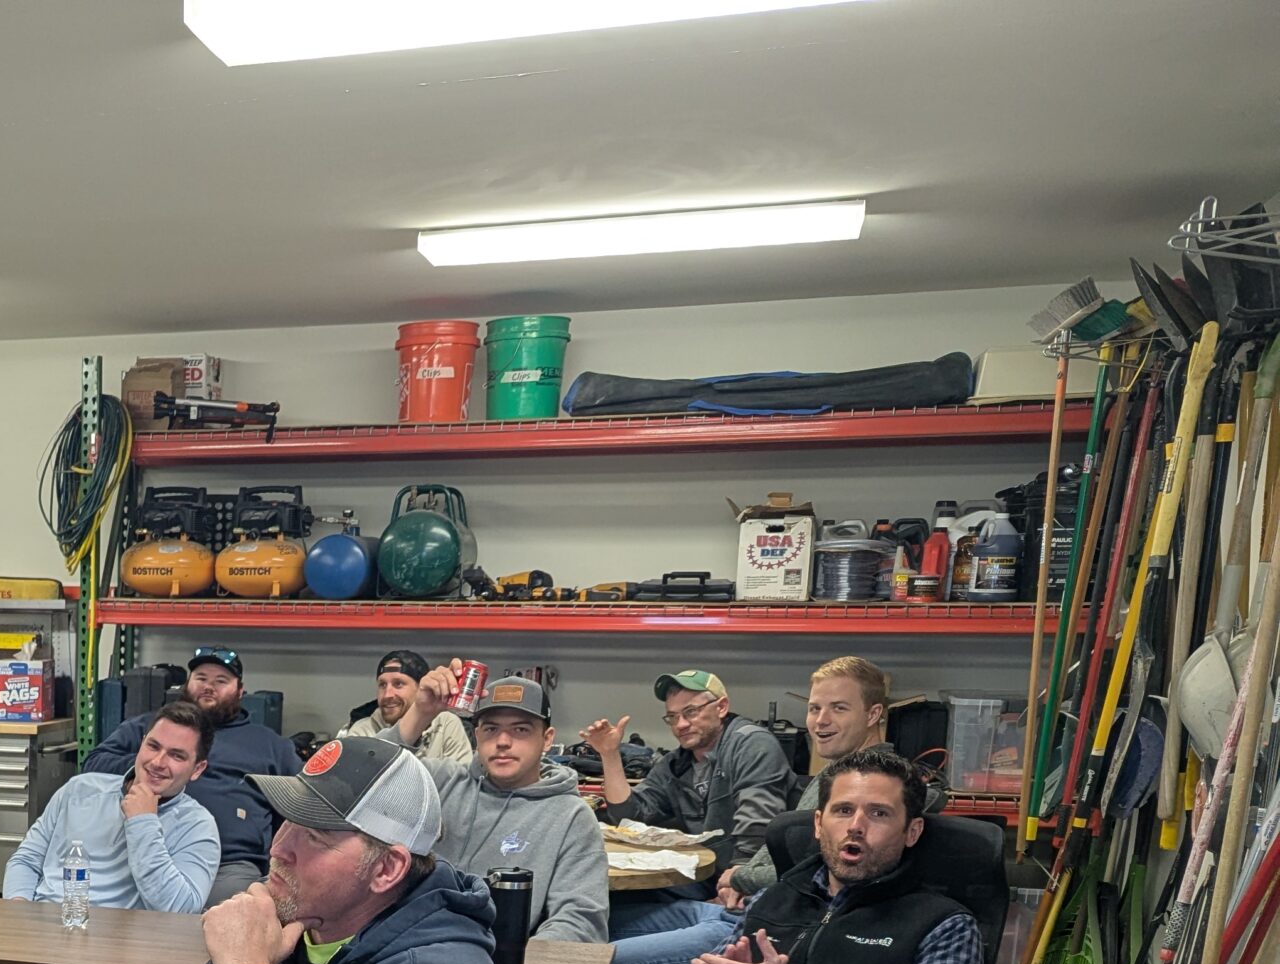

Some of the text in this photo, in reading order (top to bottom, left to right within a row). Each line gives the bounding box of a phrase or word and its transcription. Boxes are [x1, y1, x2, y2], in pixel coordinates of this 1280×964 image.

[184, 368, 203, 381] ED
[421, 369, 442, 379] Clips
[511, 372, 531, 381] Clips
[756, 535, 794, 548] USA
[760, 548, 788, 557] DEF
[132, 567, 174, 576] BOSTITCH
[228, 567, 272, 576] BOSTITCH
[985, 566, 1016, 577] Platinum
[4, 681, 30, 690] WHITE
